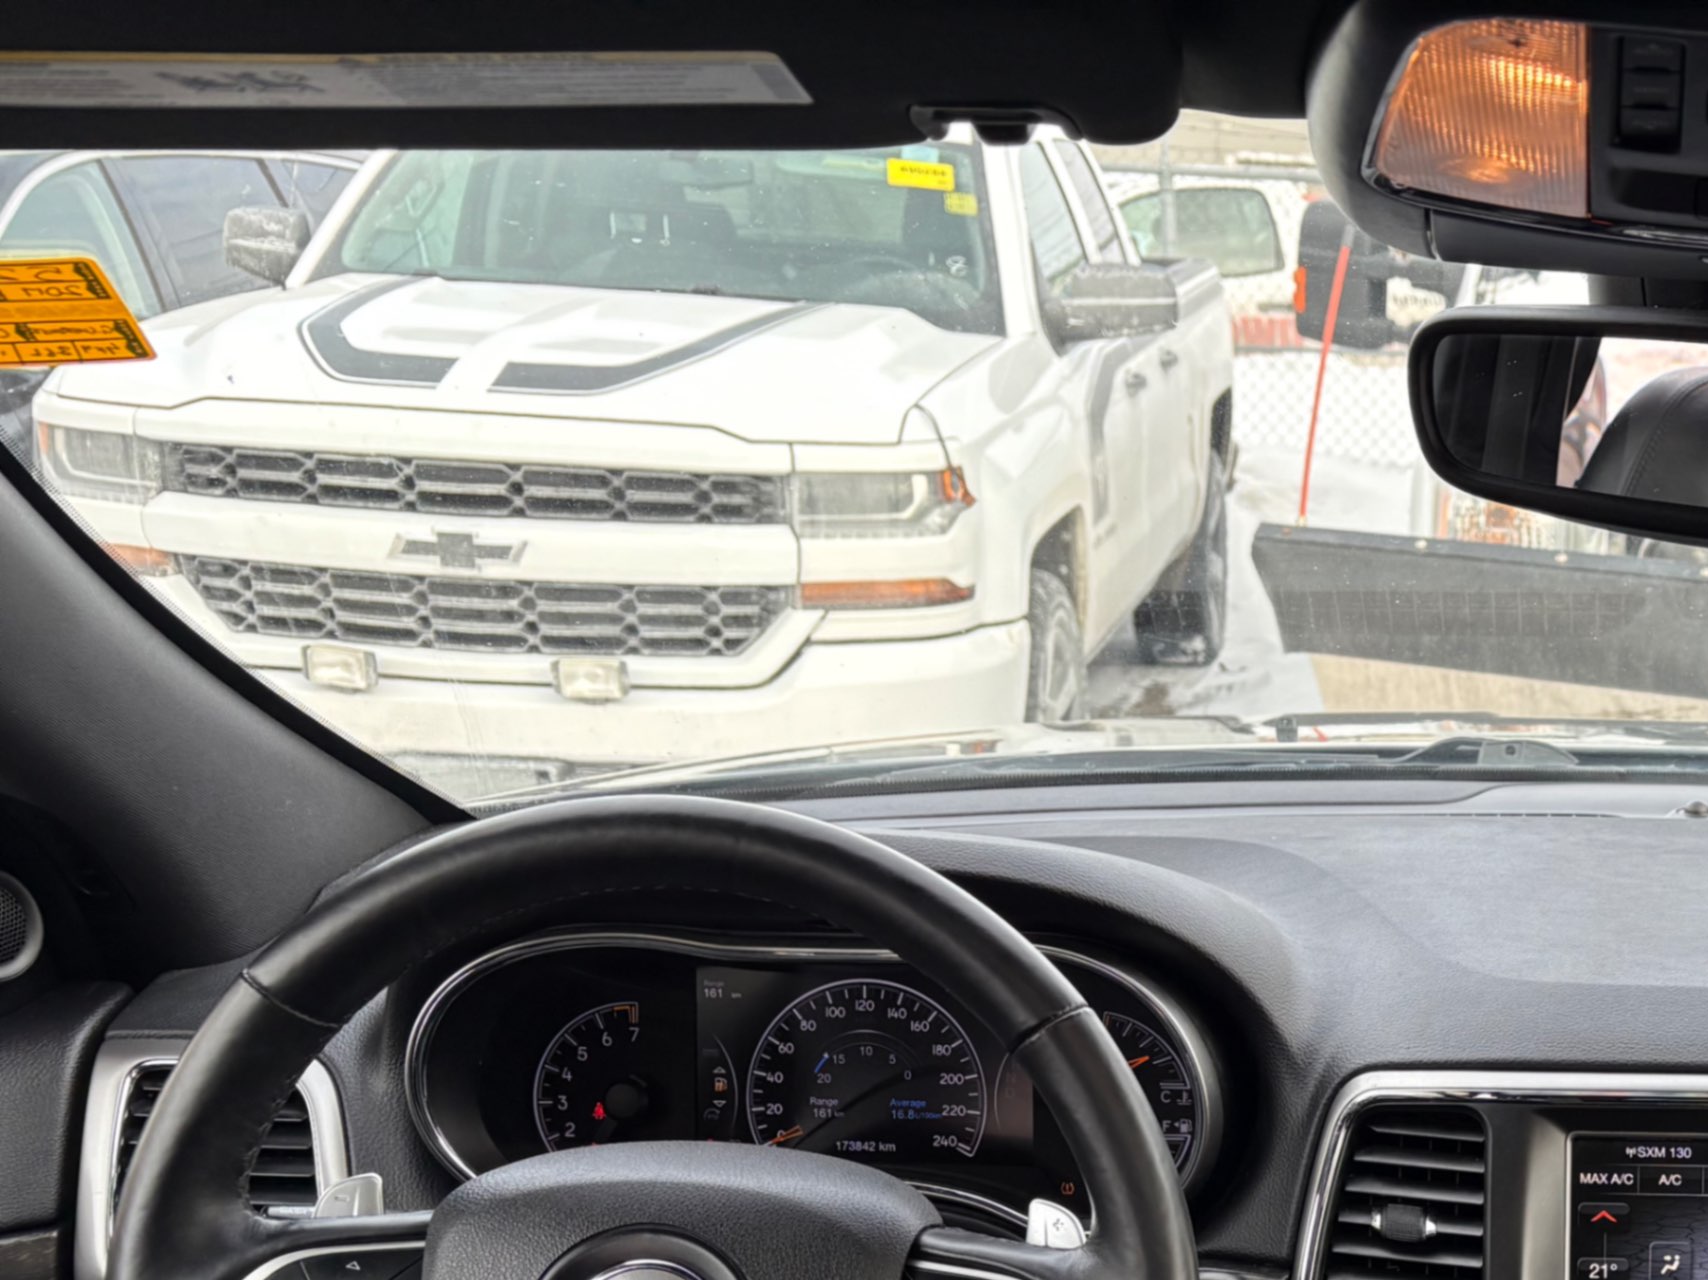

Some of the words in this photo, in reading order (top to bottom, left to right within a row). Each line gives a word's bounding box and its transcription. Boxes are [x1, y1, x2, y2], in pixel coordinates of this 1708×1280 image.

[703, 988, 723, 998] 161
[855, 1000, 875, 1012] 120
[825, 1007, 846, 1018] 100
[887, 1008, 907, 1020] 140
[800, 1020, 817, 1032] 80
[910, 1021, 930, 1032] 160
[601, 1032, 613, 1047] 6
[628, 1027, 640, 1042] 7
[577, 1046, 588, 1062] 5
[778, 1043, 794, 1054] 60
[859, 1046, 873, 1057] 10
[932, 1045, 952, 1056] 180
[833, 1054, 846, 1065] 15
[889, 1055, 896, 1065] 5
[561, 1067, 573, 1082] 4
[766, 1072, 784, 1083] 40
[817, 1073, 832, 1084] 20
[904, 1070, 912, 1081] 0
[939, 1073, 964, 1085] 200
[809, 1096, 838, 1107] Range
[1160, 1090, 1171, 1103] C
[557, 1095, 568, 1111] 3
[766, 1103, 783, 1115] 20
[890, 1098, 927, 1108] Average
[813, 1108, 832, 1118] 161
[892, 1110, 914, 1119] 16.8
[941, 1105, 966, 1117] 220
[564, 1122, 576, 1138] 2
[1162, 1120, 1172, 1132] F
[835, 1140, 876, 1152] 173842
[878, 1141, 897, 1152] km
[932, 1135, 957, 1147] 240
[1636, 1147, 1666, 1159] SXM
[1668, 1147, 1692, 1159] 130
[1579, 1172, 1607, 1185] MAX
[1609, 1173, 1634, 1186] A/C
[1658, 1174, 1682, 1187] A/C
[1588, 1263, 1617, 1280] 21°
